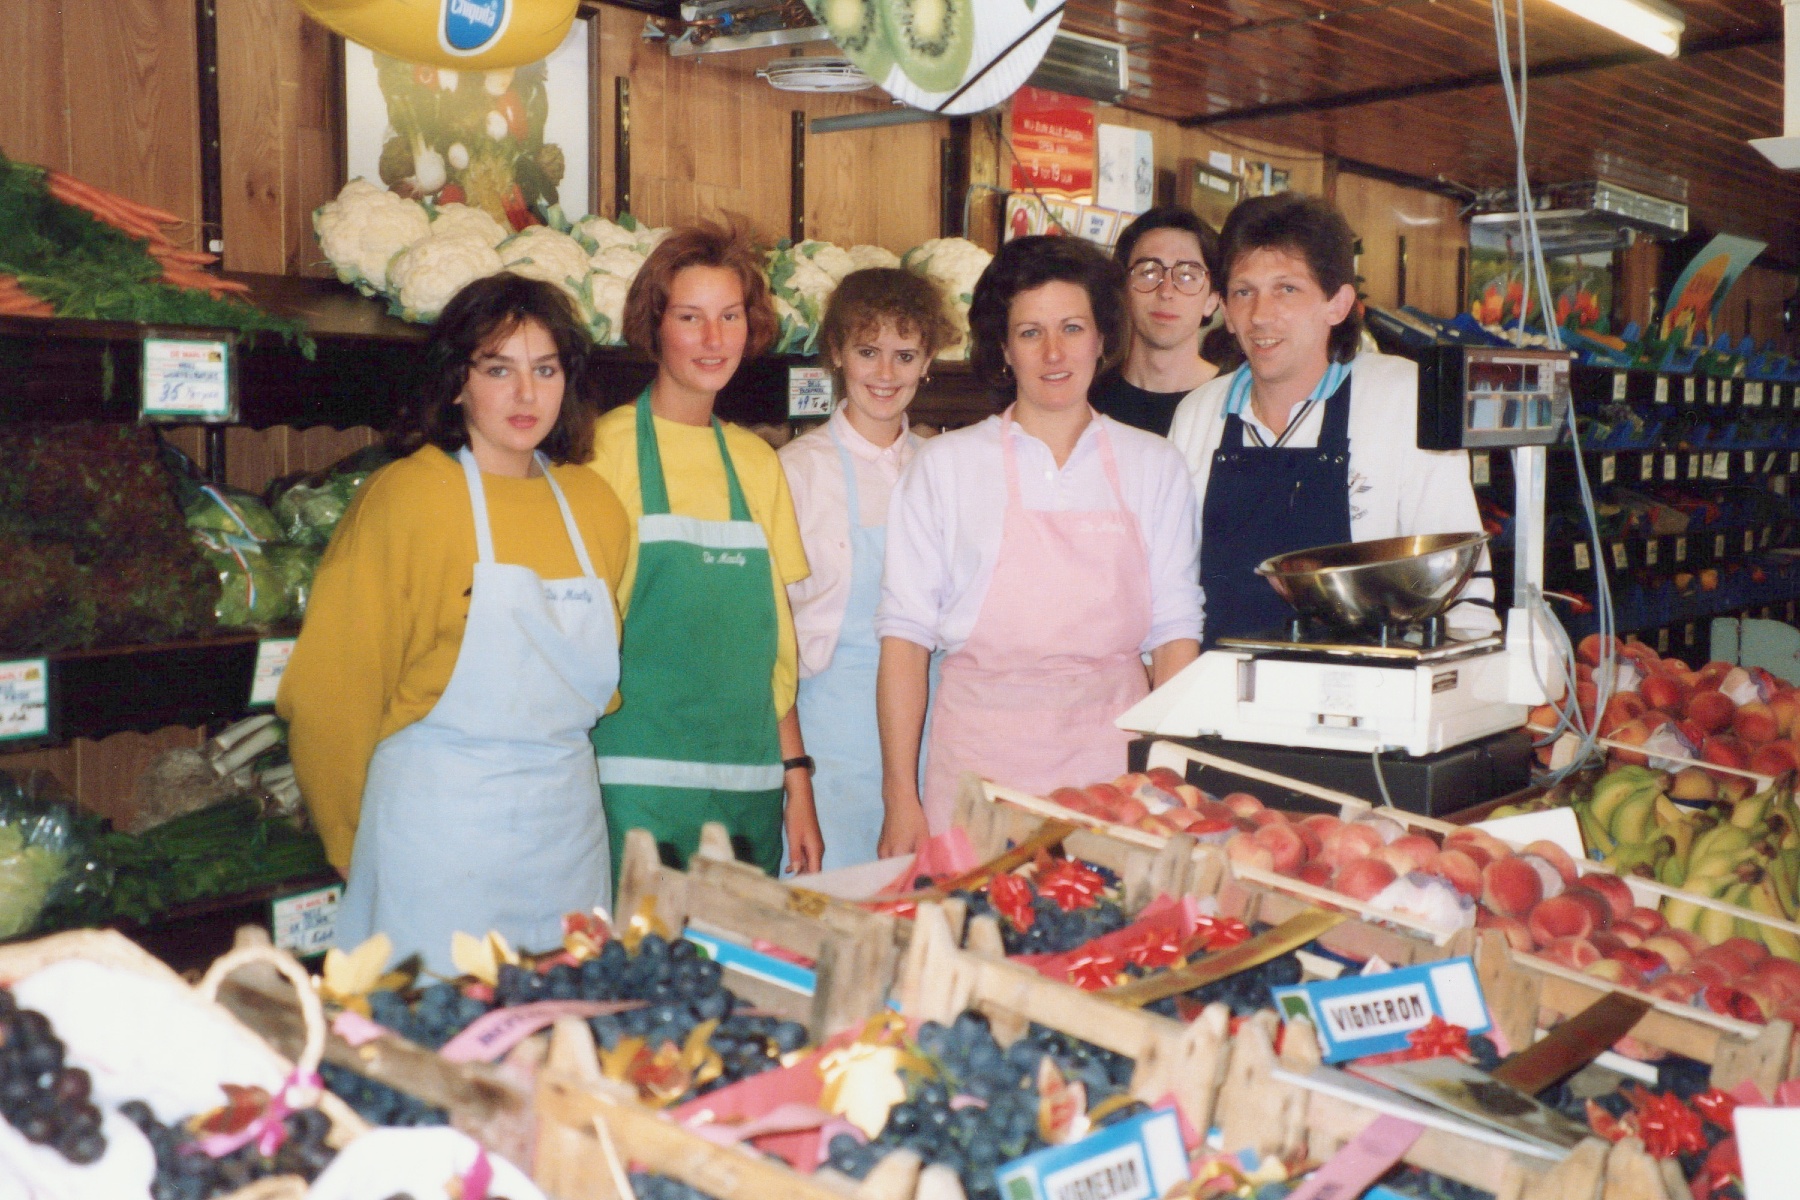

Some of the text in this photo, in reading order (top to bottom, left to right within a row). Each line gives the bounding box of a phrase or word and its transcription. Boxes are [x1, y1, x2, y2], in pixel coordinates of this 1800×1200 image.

[1032, 159, 1039, 177] 9
[1051, 162, 1060, 181] 19
[1329, 994, 1425, 1031] VIGNERON
